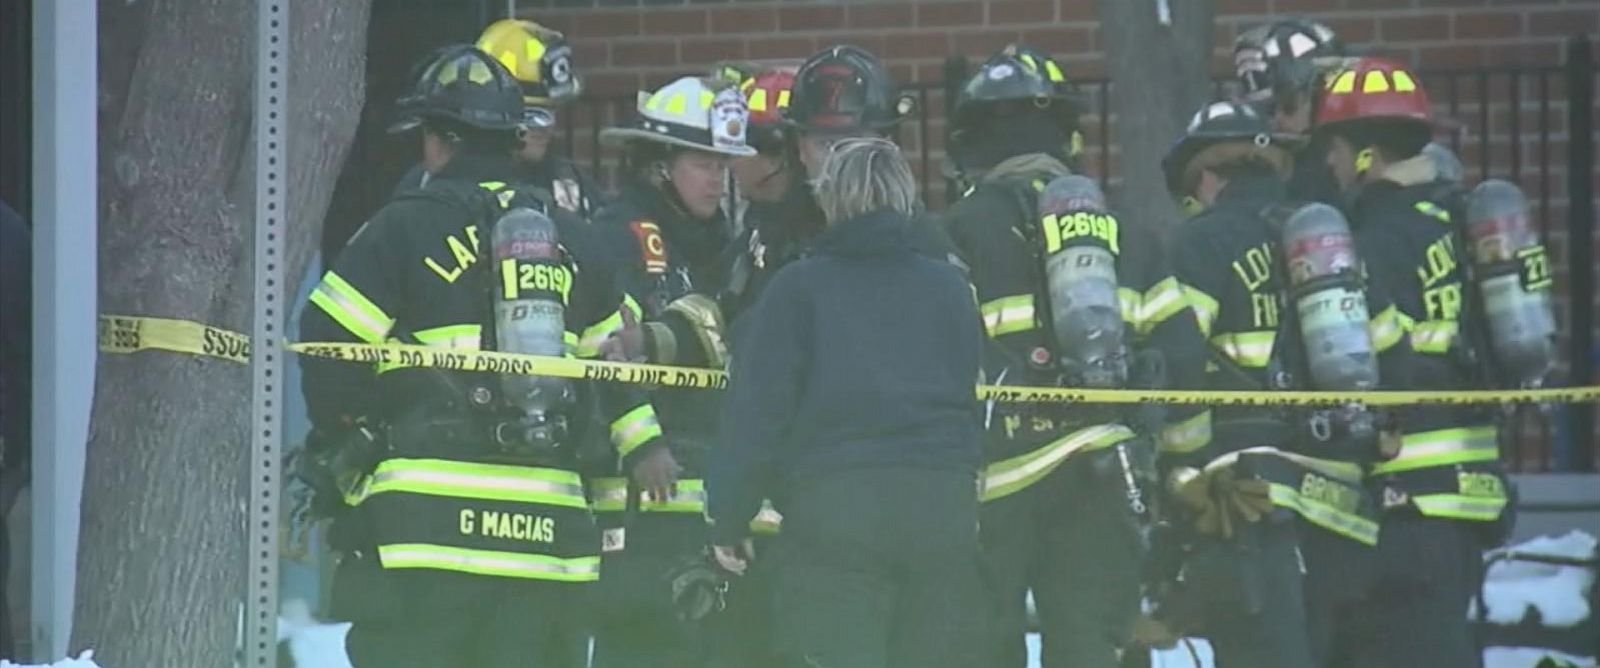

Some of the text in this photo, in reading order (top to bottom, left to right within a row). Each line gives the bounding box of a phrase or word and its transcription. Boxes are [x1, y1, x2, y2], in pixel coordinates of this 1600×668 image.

[1060, 212, 1109, 240] 2619
[647, 233, 663, 256] C
[519, 264, 564, 292] 2619
[460, 509, 555, 544] G MACIAS
